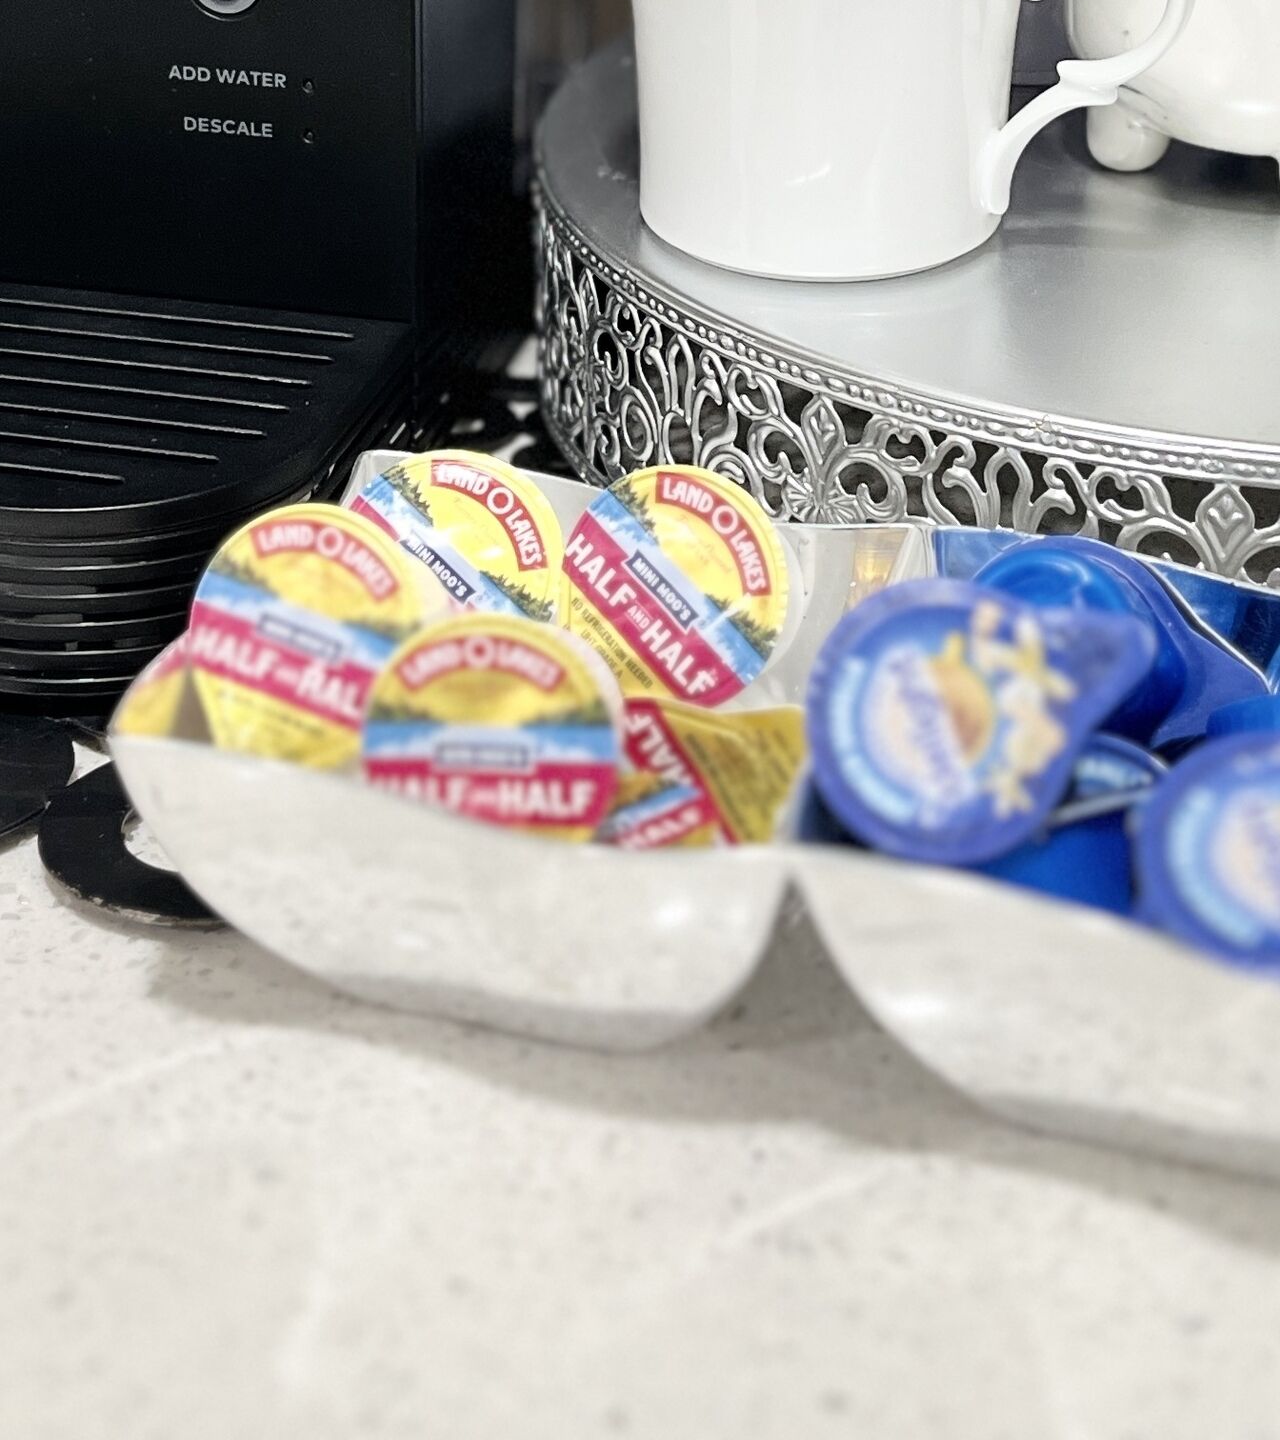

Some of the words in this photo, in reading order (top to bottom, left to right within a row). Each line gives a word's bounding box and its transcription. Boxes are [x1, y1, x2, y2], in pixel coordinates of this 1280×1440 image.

[168, 65, 211, 82] ADD
[216, 68, 287, 88] WATER
[183, 116, 273, 138] DESCALE
[257, 523, 314, 552] LAND
[434, 463, 490, 496] LAND
[504, 508, 544, 566] LAKES
[662, 477, 714, 510] LAND
[730, 528, 767, 592] LAKES
[431, 560, 468, 598] MOO'S
[631, 556, 658, 589] MINI
[656, 581, 693, 621] MOO'S
[565, 532, 638, 608] HALF
[627, 603, 651, 629] AND
[639, 617, 718, 696] HALF
[581, 606, 626, 660] REFRIGERATION
[191, 626, 279, 680] HALF
[296, 660, 365, 720] HAL
[498, 779, 596, 818] HALF
